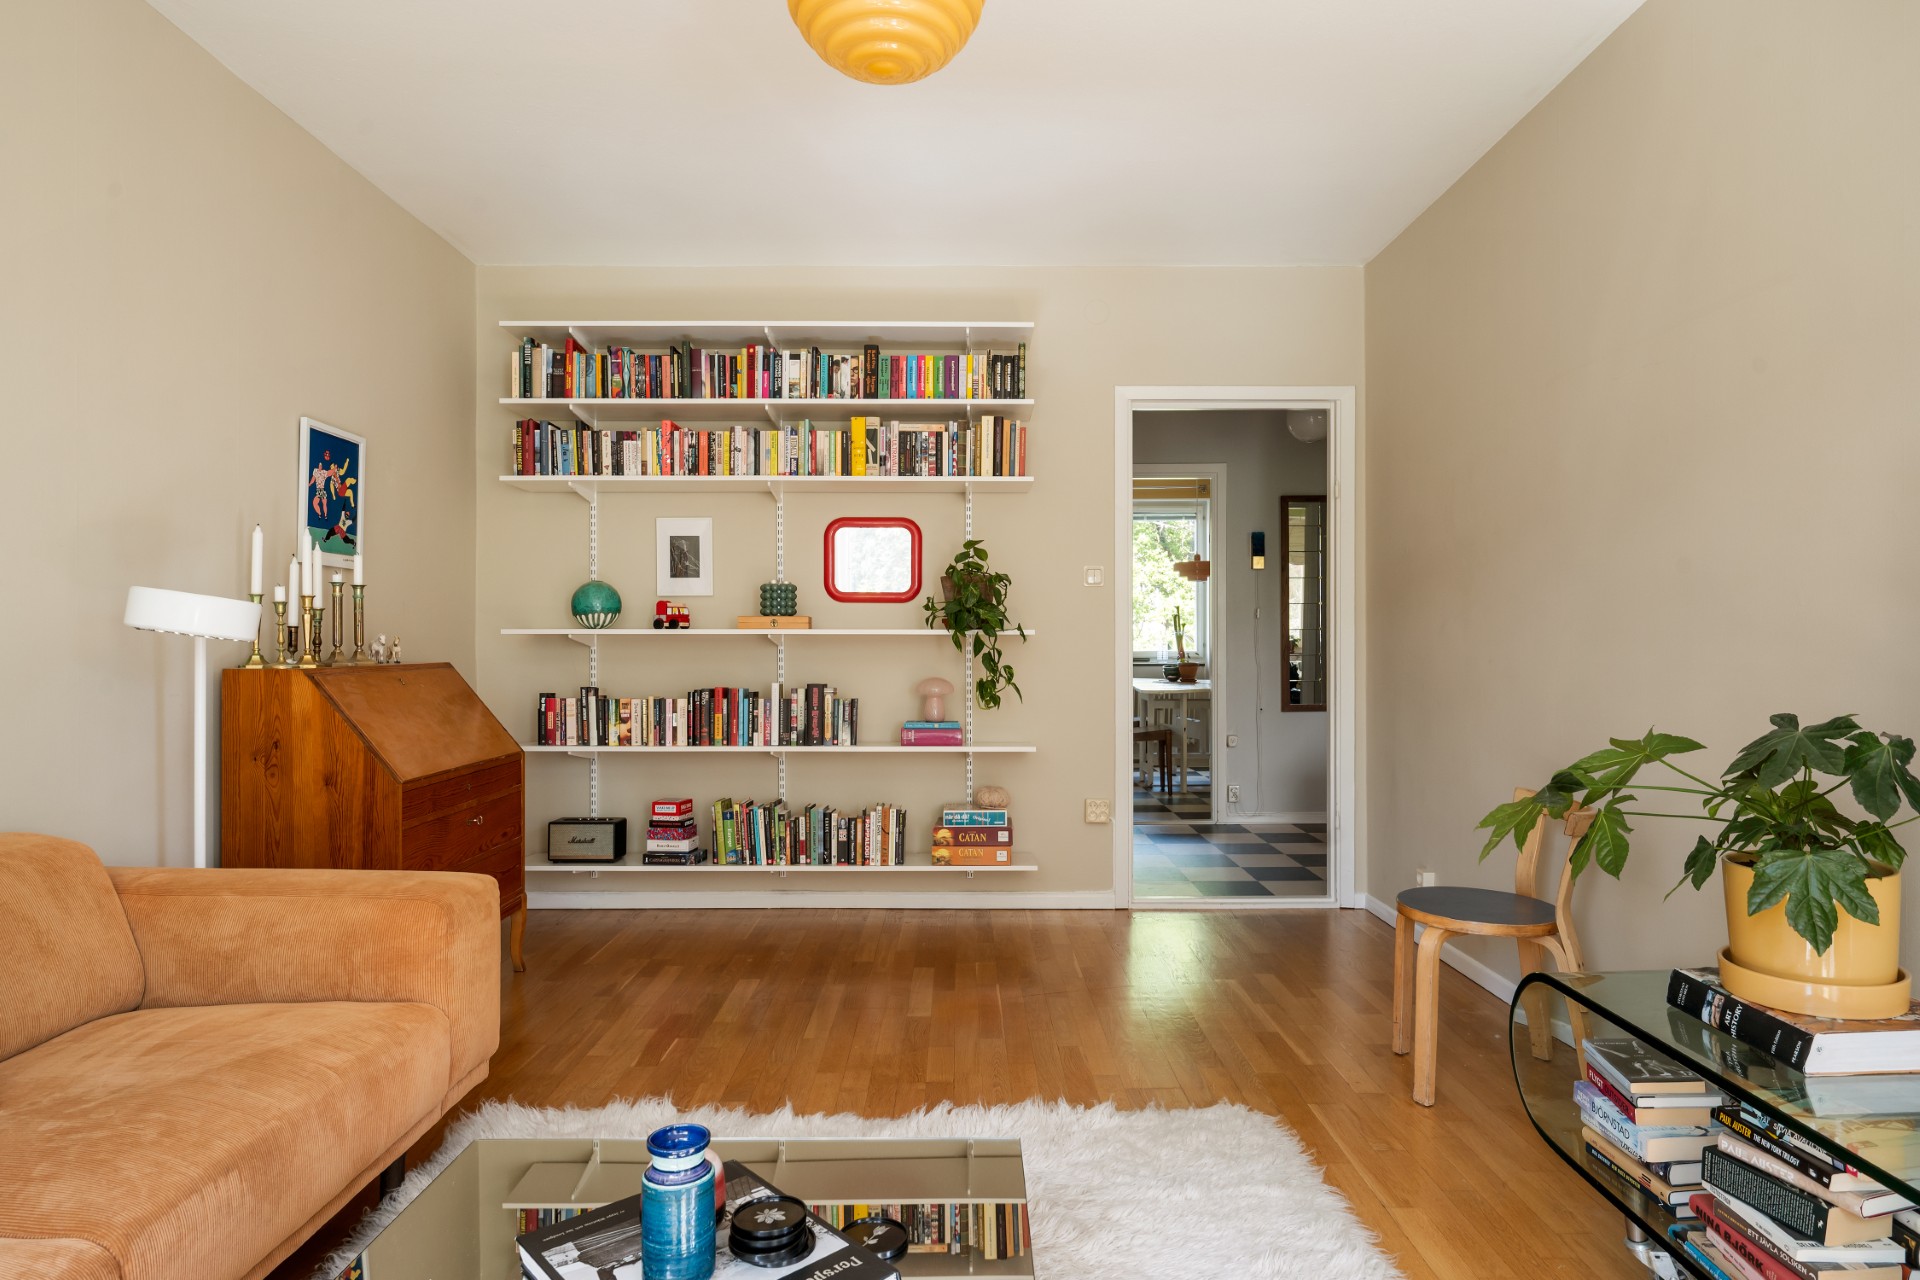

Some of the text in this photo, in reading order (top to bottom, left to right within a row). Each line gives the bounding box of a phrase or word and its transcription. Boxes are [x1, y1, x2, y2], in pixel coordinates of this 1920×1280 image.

[958, 832, 987, 843] CATAN
[958, 848, 984, 857] CATAN
[1724, 1009, 1733, 1026] ART
[1730, 1003, 1743, 1039] HISTORY
[1591, 1101, 1630, 1140] BJÖRNSTAD
[1719, 1111, 1800, 1167] PAUL AUSTER THE NEW YORK TRILOGY
[1721, 1139, 1795, 1181] PAUL AUSTER
[1695, 1205, 1721, 1234] NINA
[1723, 1230, 1764, 1273] BJÖRK
[1747, 1226, 1808, 1275] ETT JÄVLA SOLSKEN
[805, 1256, 864, 1280] Persp
